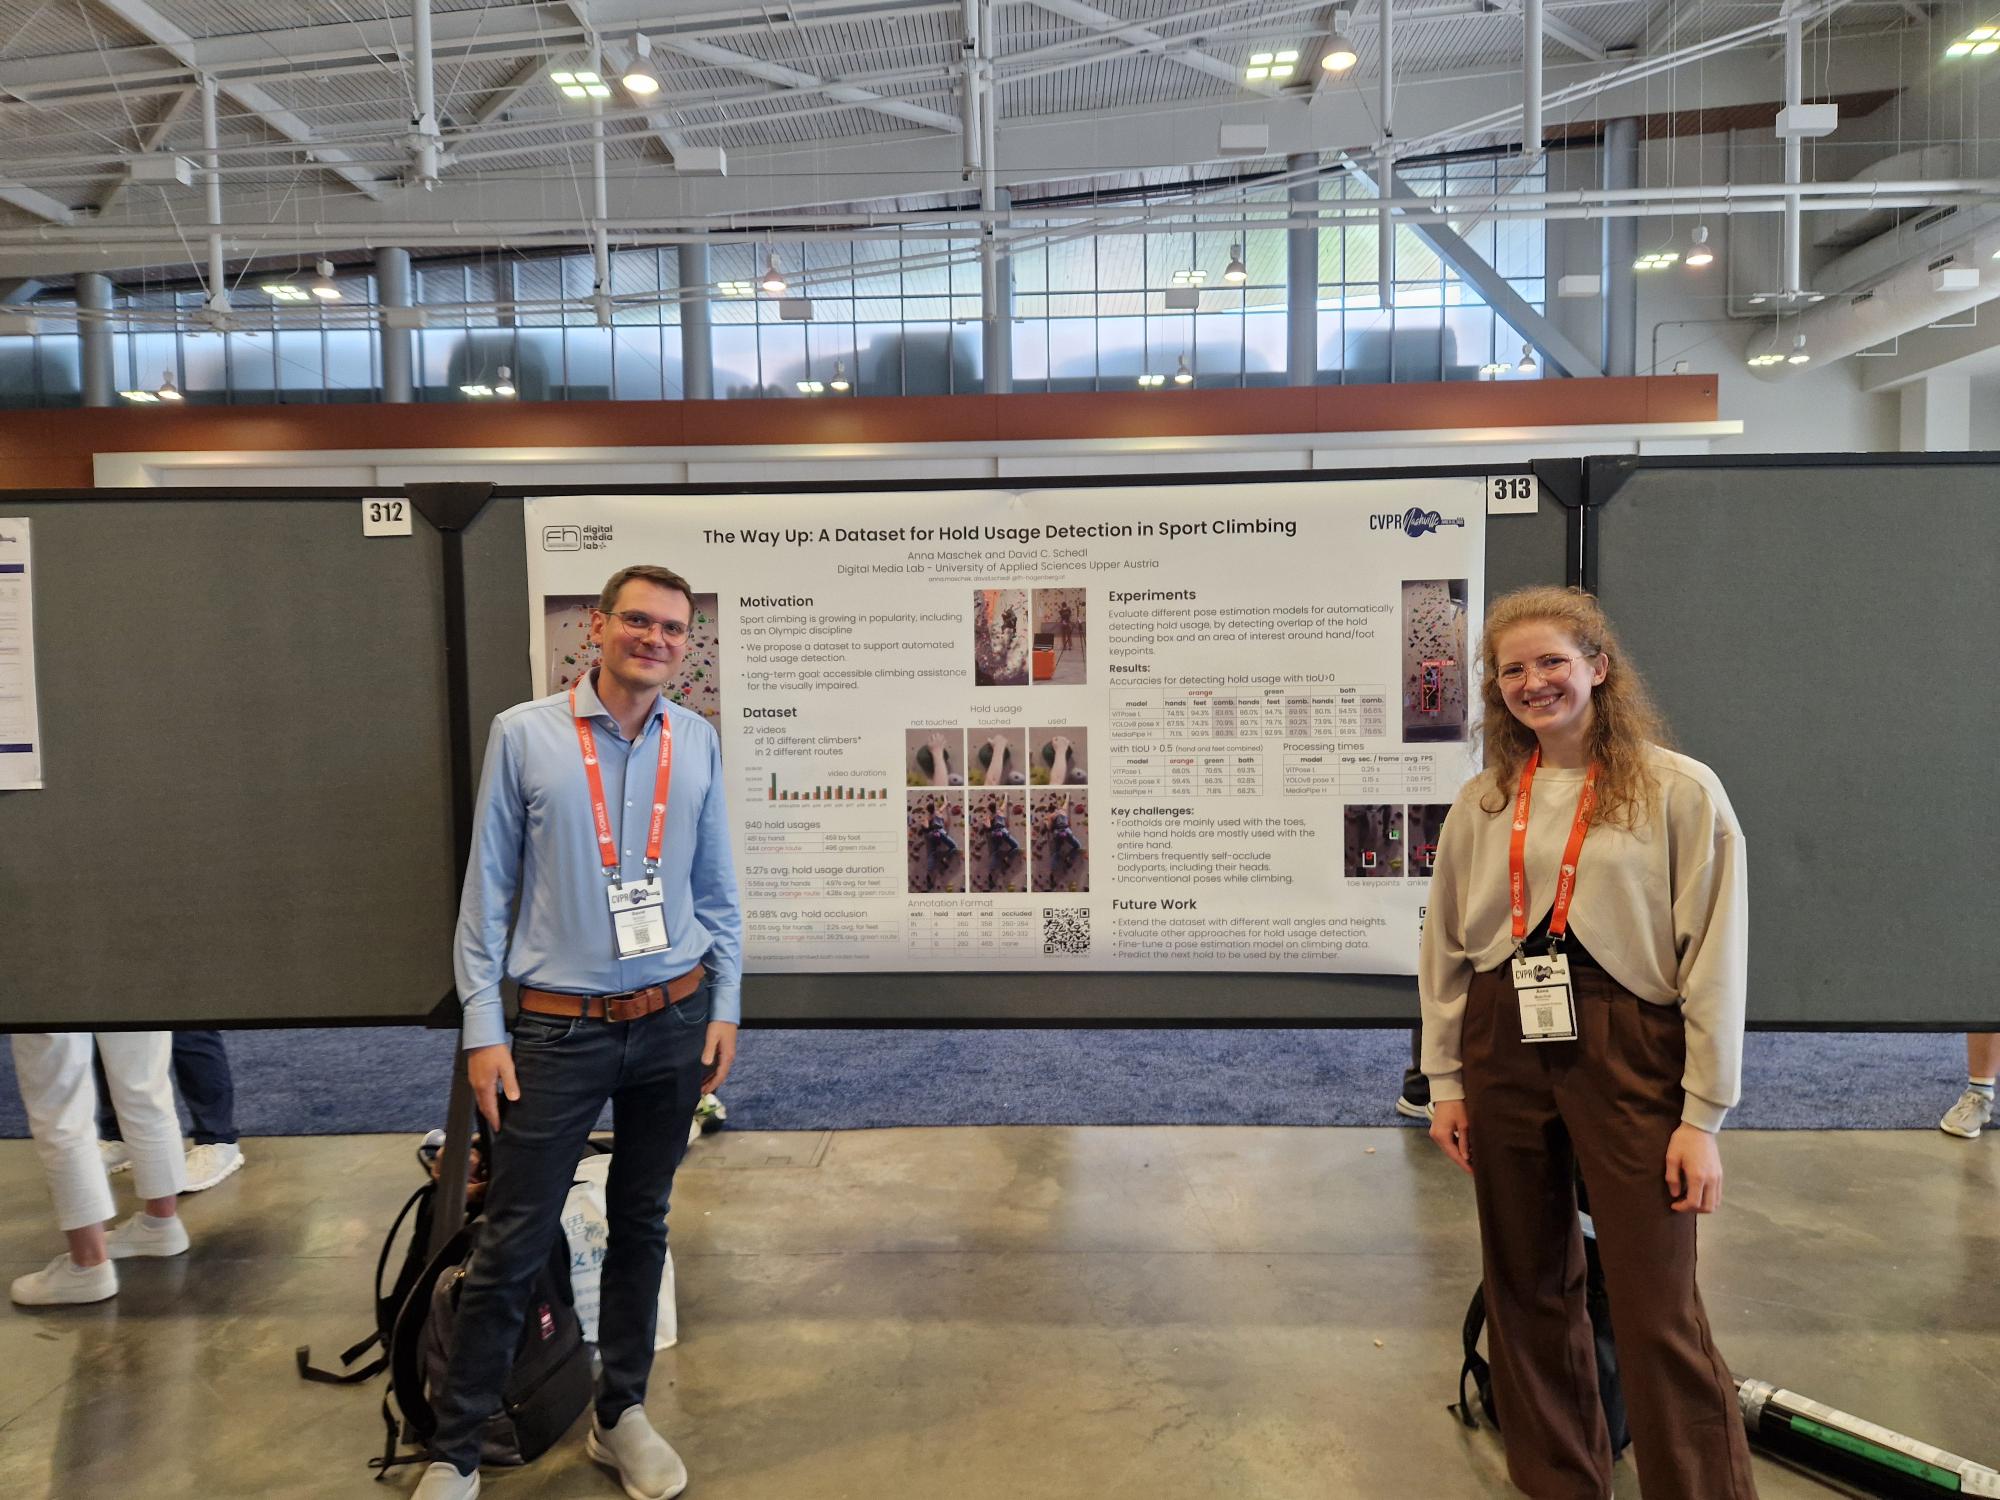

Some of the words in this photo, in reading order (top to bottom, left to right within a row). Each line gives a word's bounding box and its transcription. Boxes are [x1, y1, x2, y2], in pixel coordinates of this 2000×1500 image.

[1494, 478, 1530, 500] 313
[370, 502, 402, 522] 312
[1370, 514, 1402, 530] CVPR
[583, 525, 613, 534] digital
[702, 529, 735, 543] The
[739, 529, 780, 547] Way
[785, 528, 813, 547] Up:
[818, 528, 830, 542] A
[835, 527, 905, 542] Dataset
[910, 526, 934, 540] for
[939, 525, 978, 540] Hold
[984, 525, 1040, 544] Usage
[1045, 521, 1132, 538] Detection
[1137, 521, 1153, 536] in
[1158, 520, 1207, 540] Sport
[1212, 517, 1296, 538] Climbing
[583, 532, 613, 541] media
[583, 542, 598, 550] lab
[907, 551, 936, 560] Anna
[936, 549, 982, 560] Maschek
[984, 550, 1005, 560] and
[1008, 549, 1038, 558] David
[1053, 548, 1088, 559] Schedl
[837, 564, 869, 576] Digital
[872, 563, 903, 573] Media
[906, 563, 925, 572] Lab
[935, 562, 983, 575] University
[988, 562, 996, 571] of
[999, 561, 1038, 573] Applied
[1040, 558, 1086, 571] Sciences
[1089, 560, 1120, 572] Upper
[1123, 558, 1159, 568] Austria
[740, 594, 813, 607] Motivation
[1109, 588, 1196, 604] Experiments
[1108, 607, 1150, 618] Evaluate
[1150, 607, 1191, 618] different
[1193, 608, 1217, 619] pose
[1219, 606, 1270, 616] estimation
[1272, 605, 1308, 617] models
[1311, 604, 1325, 616] for
[1326, 603, 1394, 615] automatically
[740, 615, 764, 626] Sport
[767, 614, 806, 626] climbing
[809, 614, 816, 622] is
[818, 615, 856, 625] growing
[919, 612, 962, 624] including
[1108, 620, 1154, 632] detecting
[1156, 620, 1178, 631] hold
[1213, 619, 1226, 630] by
[1227, 618, 1274, 630] detecting
[1276, 618, 1314, 629] overlap
[1315, 617, 1326, 627] of
[1327, 617, 1344, 626] the
[1345, 616, 1367, 629] hold
[754, 625, 766, 635] an
[768, 624, 807, 637] Olympic
[808, 624, 852, 636] discipline
[746, 643, 762, 651] We
[763, 643, 802, 653] propose
[813, 641, 849, 653] dataset
[863, 641, 899, 652] support
[901, 640, 954, 650] automated
[746, 652, 768, 663] hold
[769, 652, 800, 664] usage
[1109, 663, 1150, 672] Results:
[746, 670, 796, 680] Long-term
[822, 668, 872, 680] accessible
[874, 668, 915, 679] climbing
[916, 668, 966, 677] assistance
[1109, 676, 1162, 686] Accuracies
[1163, 675, 1178, 685] for
[1178, 675, 1224, 686] detecting
[1227, 674, 1248, 684] hold
[1250, 675, 1281, 685] usage
[1282, 673, 1303, 682] with
[747, 681, 760, 690] for
[761, 679, 778, 690] the
[779, 679, 813, 692] visually
[743, 706, 797, 718] Dataset
[970, 704, 991, 712] Hold
[993, 705, 1022, 714] usage
[743, 725, 754, 734] 22
[755, 725, 786, 735] videos
[754, 736, 764, 745] of
[766, 736, 775, 745] 10
[776, 735, 816, 746] different
[754, 748, 764, 756] in
[764, 747, 772, 756] 2
[772, 746, 812, 756] different
[813, 747, 843, 756] routes
[1282, 742, 1335, 753] Processing
[1337, 741, 1364, 750] times
[1111, 807, 1130, 818] Key
[1132, 806, 1194, 818] challenges:
[744, 820, 763, 830] 940
[764, 820, 785, 830] hold
[786, 822, 820, 830] usages
[1117, 817, 1163, 827] Footholds
[1165, 819, 1180, 827] are
[1182, 817, 1215, 828] mainly
[1217, 817, 1240, 826] used
[1242, 817, 1263, 826] with
[1265, 817, 1281, 826] the
[1116, 851, 1160, 862] Climbers
[1160, 850, 1209, 862] frequently
[1211, 850, 1271, 860] self-occlude
[745, 866, 768, 874] 5.27s
[791, 865, 812, 874] hold
[814, 865, 843, 876] usage
[845, 864, 884, 873] duration
[1117, 874, 1190, 884] Unconventional
[1192, 875, 1222, 885] poses
[1223, 874, 1249, 882] while
[1250, 873, 1294, 884] climbing.
[1112, 898, 1157, 909] Future
[1160, 898, 1196, 909] Work
[746, 910, 778, 918] 26.98%
[801, 910, 822, 918] hold
[823, 909, 867, 919] occlusion
[1516, 968, 1532, 980] CVPR
